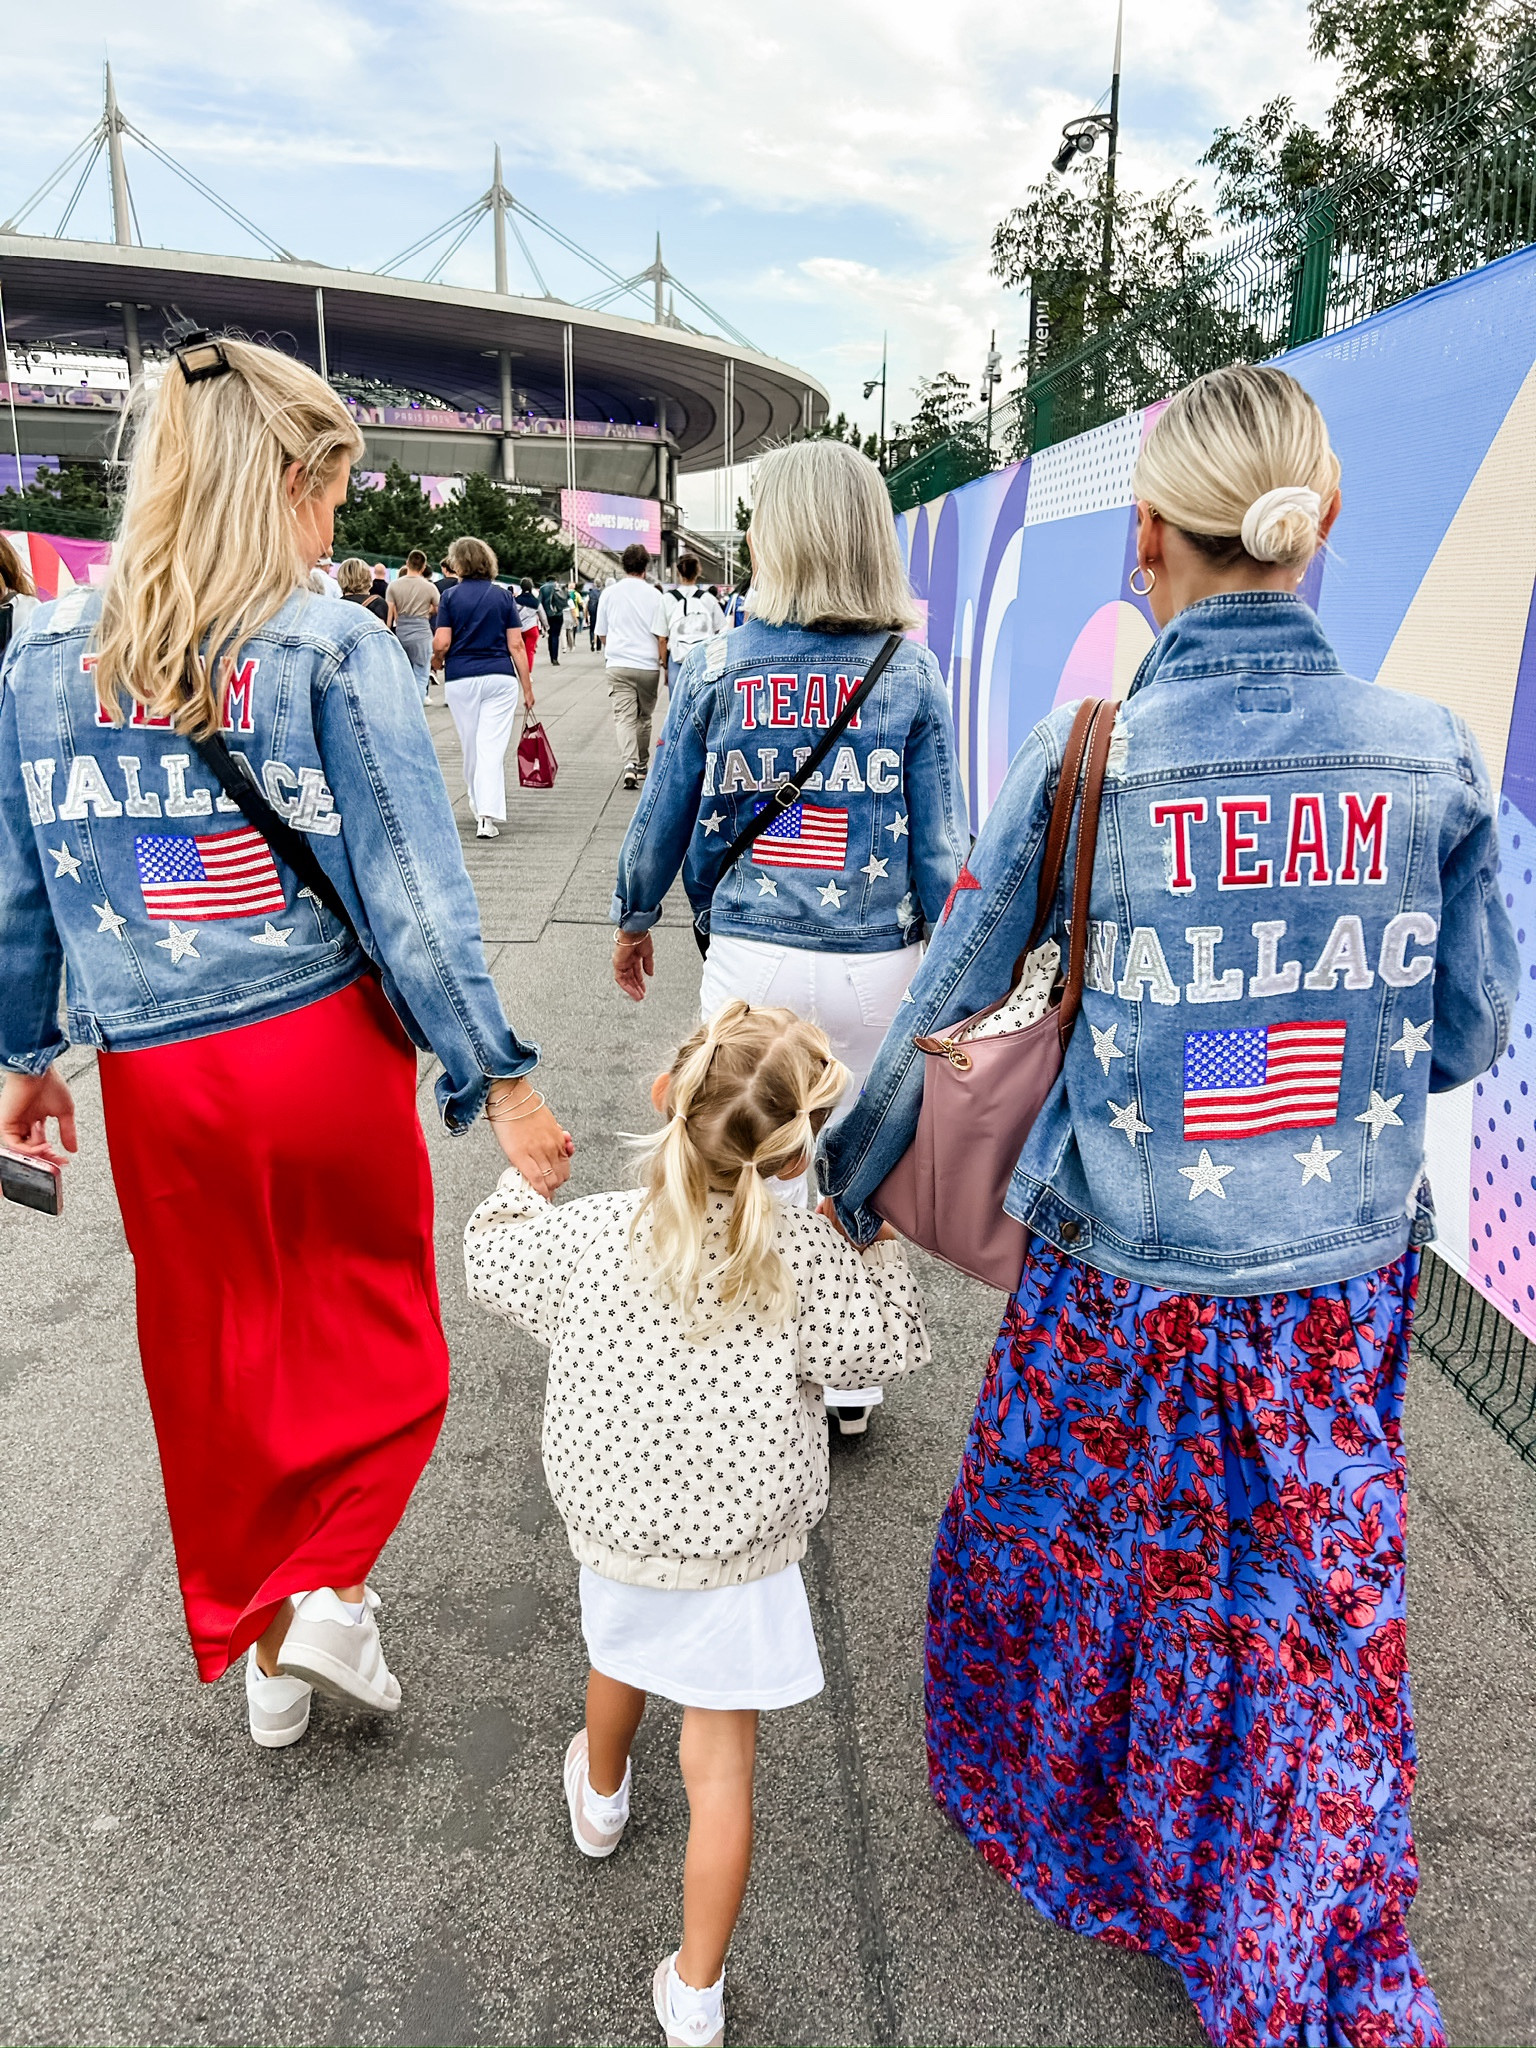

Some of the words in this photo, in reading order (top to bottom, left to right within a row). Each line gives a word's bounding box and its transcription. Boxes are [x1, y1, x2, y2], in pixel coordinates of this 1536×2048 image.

[394, 412, 423, 423] PARIS
[425, 413, 450, 424] 2024
[588, 512, 616, 529] GAMES
[702, 746, 905, 797] ALLAC
[1150, 792, 1392, 894] TEAM
[1064, 911, 1441, 1006] WALLAC
